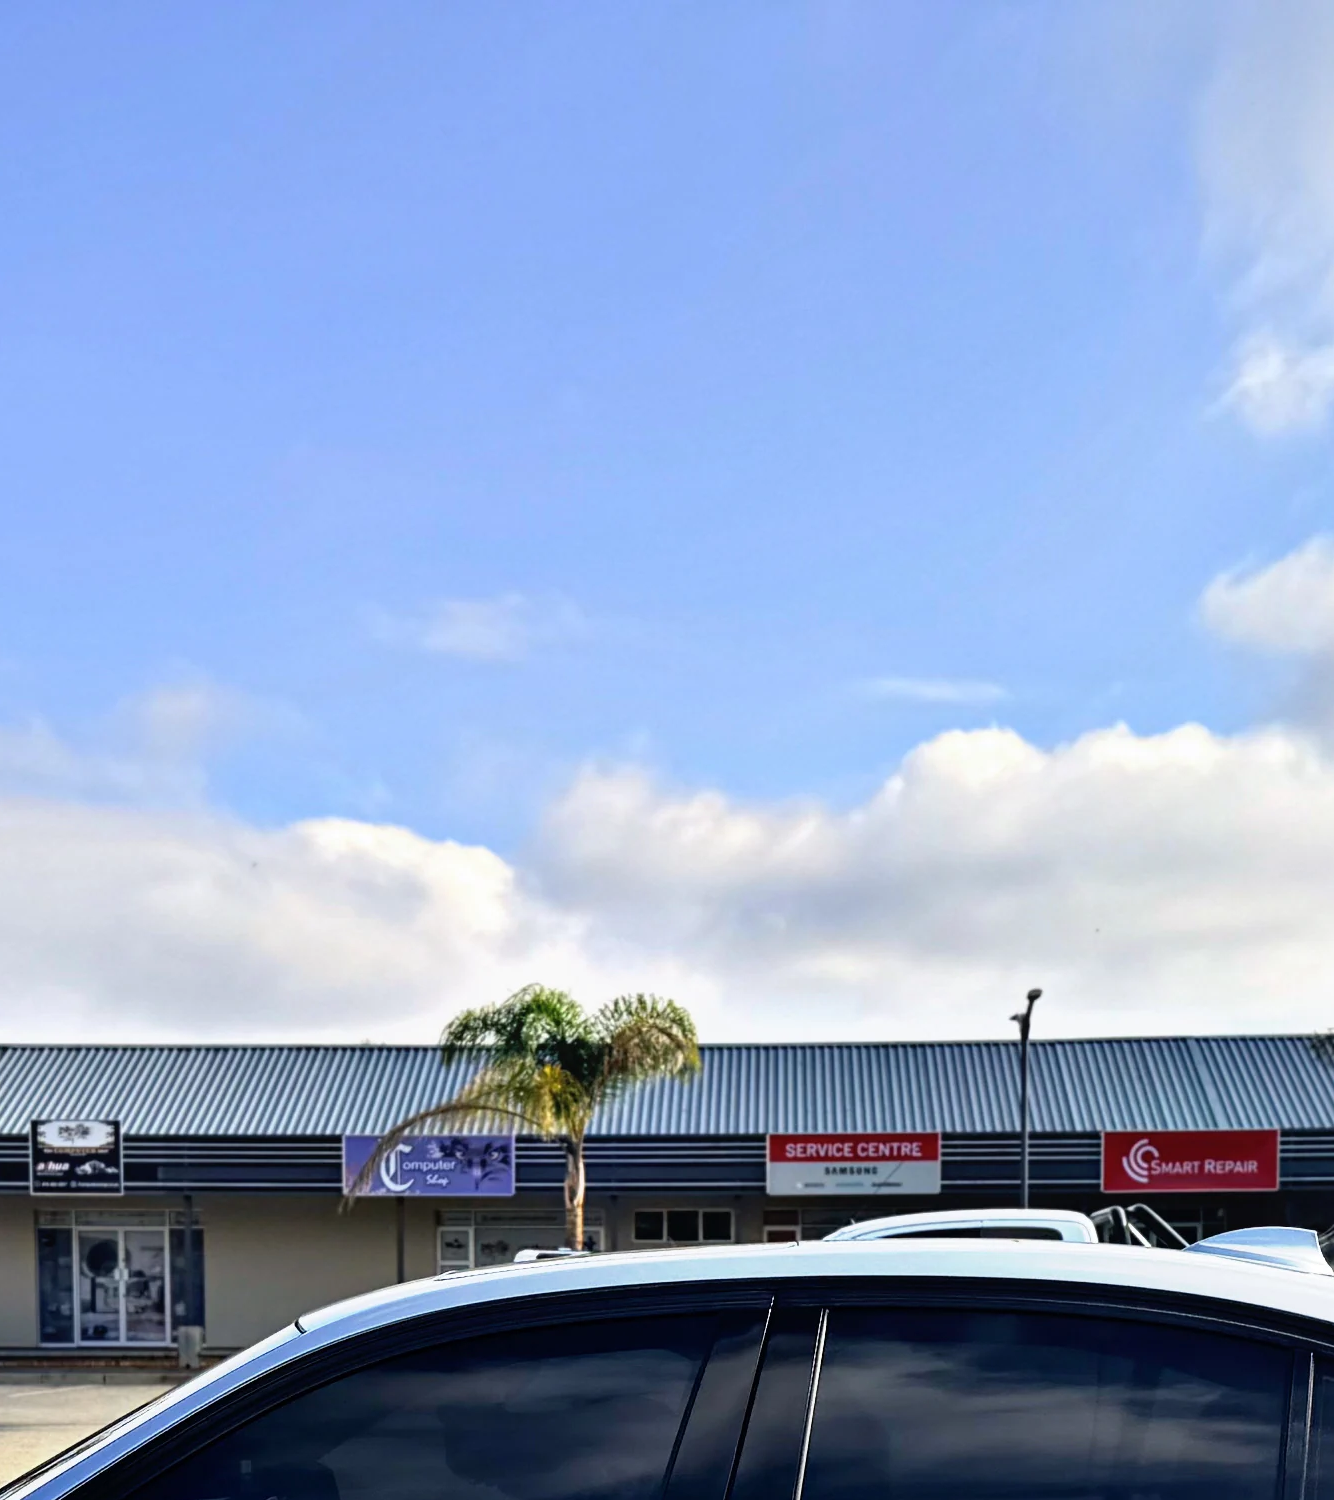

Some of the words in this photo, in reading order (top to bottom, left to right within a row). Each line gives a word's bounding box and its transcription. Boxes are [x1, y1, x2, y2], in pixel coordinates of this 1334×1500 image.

[785, 1142, 854, 1158] SERVICE
[857, 1142, 923, 1157] CENTRE
[824, 1167, 879, 1176] SAMSUNG
[1151, 1160, 1201, 1175] SMART
[1204, 1159, 1259, 1174] REPAIR
[426, 1174, 449, 1187] Shop
